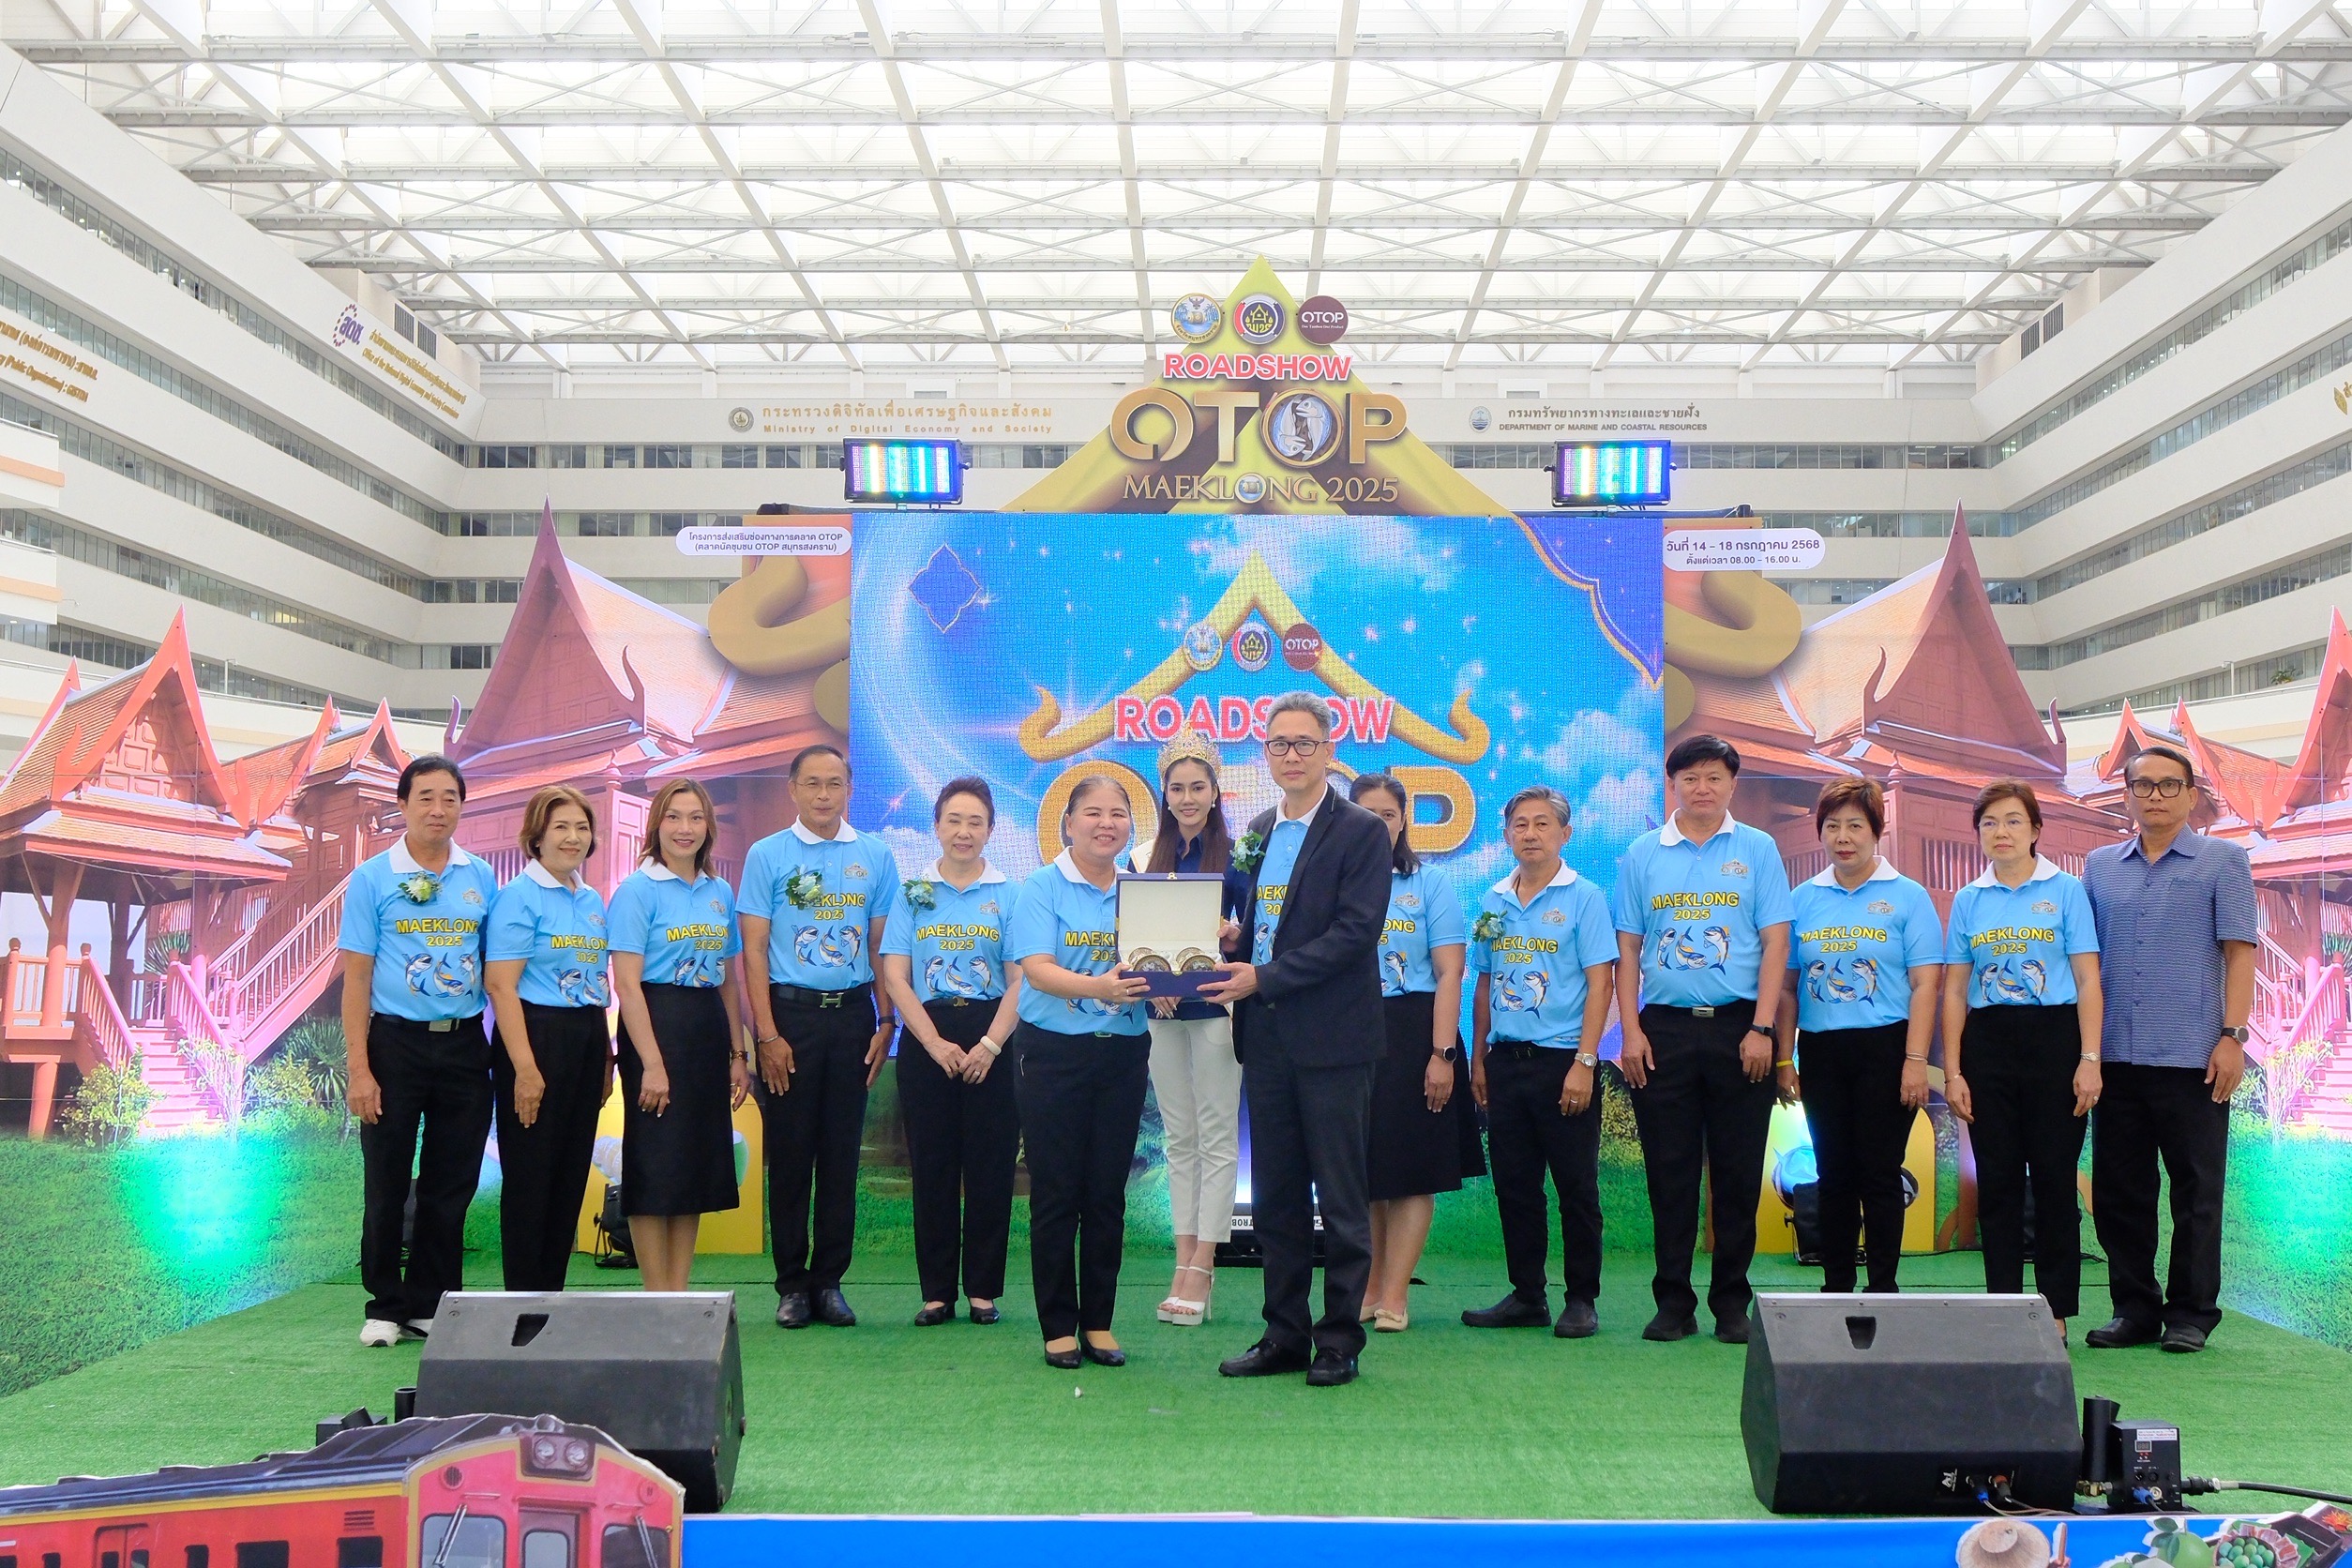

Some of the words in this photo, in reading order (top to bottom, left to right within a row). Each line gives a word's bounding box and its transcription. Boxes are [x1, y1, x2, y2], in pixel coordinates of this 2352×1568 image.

[1302, 311, 1344, 323] OTOP
[1164, 353, 1352, 380] ROADSHOW
[762, 400, 1052, 421] กระทรวงดิจิทัลเพื่อเศรษฐกิจและสังคม
[1508, 402, 1700, 418] กรมทรัพยากรทางทะเลและชายฝั่ง
[764, 425, 816, 434] Ministry
[827, 425, 839, 433] of
[851, 425, 893, 434] Digital
[905, 425, 960, 434] Economy
[972, 425, 993, 433] and
[1004, 425, 1052, 434] Society
[1109, 386, 1407, 468] OTOP
[1123, 472, 1317, 504] MAEKLONG
[1326, 476, 1398, 502] 2025
[689, 532, 816, 541] โครงการส่งเสริมช่องทางการตลาด
[695, 543, 752, 552] (ตลาดนัดชุมชน
[781, 543, 837, 552] สมุทรสงคราม)
[1666, 537, 1689, 551] วันที่
[1693, 542, 1706, 550] 14
[1719, 541, 1732, 550] 18
[1736, 540, 1787, 552] กรกฎาคม
[1791, 539, 1820, 550] 2568
[1686, 553, 1727, 565] ตั้งแต่เวลา
[1285, 639, 1319, 650] OTOP
[1115, 695, 1395, 744] ROADSOW
[1651, 891, 1740, 911] MAEKLONG
[814, 909, 844, 920] 2025
[1265, 903, 1281, 915] 20
[1673, 909, 1711, 921] 2025
[916, 924, 1000, 942] MAEKLONG
[1801, 926, 1887, 943] MAEKLONG
[1971, 927, 2054, 948] MAEKLONG
[426, 935, 462, 946] 2025
[551, 935, 608, 950] MAEKLON
[695, 940, 722, 951] 2025
[939, 939, 975, 951] 2025
[1820, 941, 1857, 953] 2025
[1092, 949, 1115, 962] 202
[1992, 942, 2027, 956] 2025
